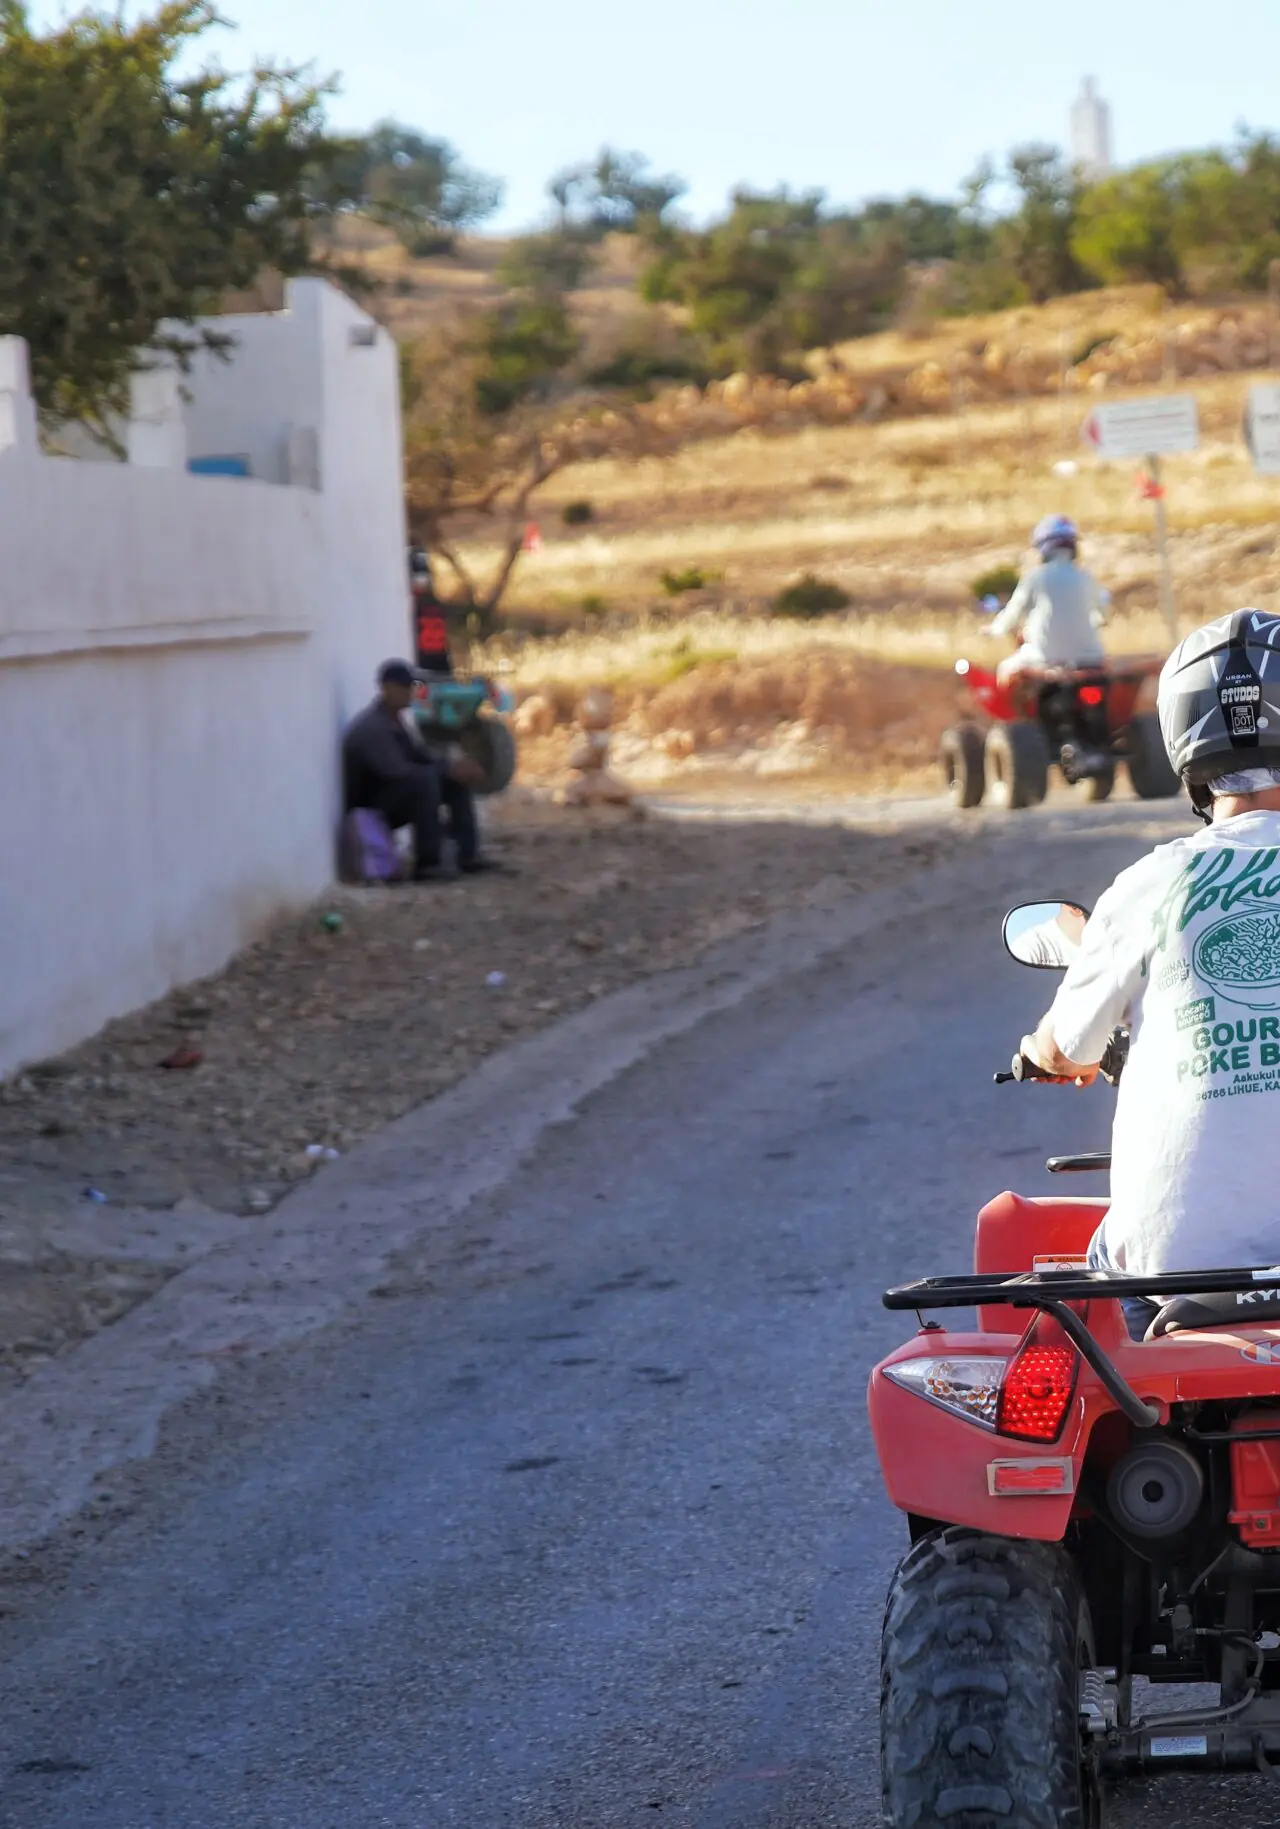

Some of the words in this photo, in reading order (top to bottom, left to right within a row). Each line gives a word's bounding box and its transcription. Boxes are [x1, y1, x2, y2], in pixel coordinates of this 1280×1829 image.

[1225, 673, 1252, 681] URBAN
[1221, 686, 1260, 704] STUDDS
[1234, 716, 1252, 726] DOT
[1176, 1045, 1251, 1083] POKE
[1227, 1081, 1264, 1097] LIHUE,
